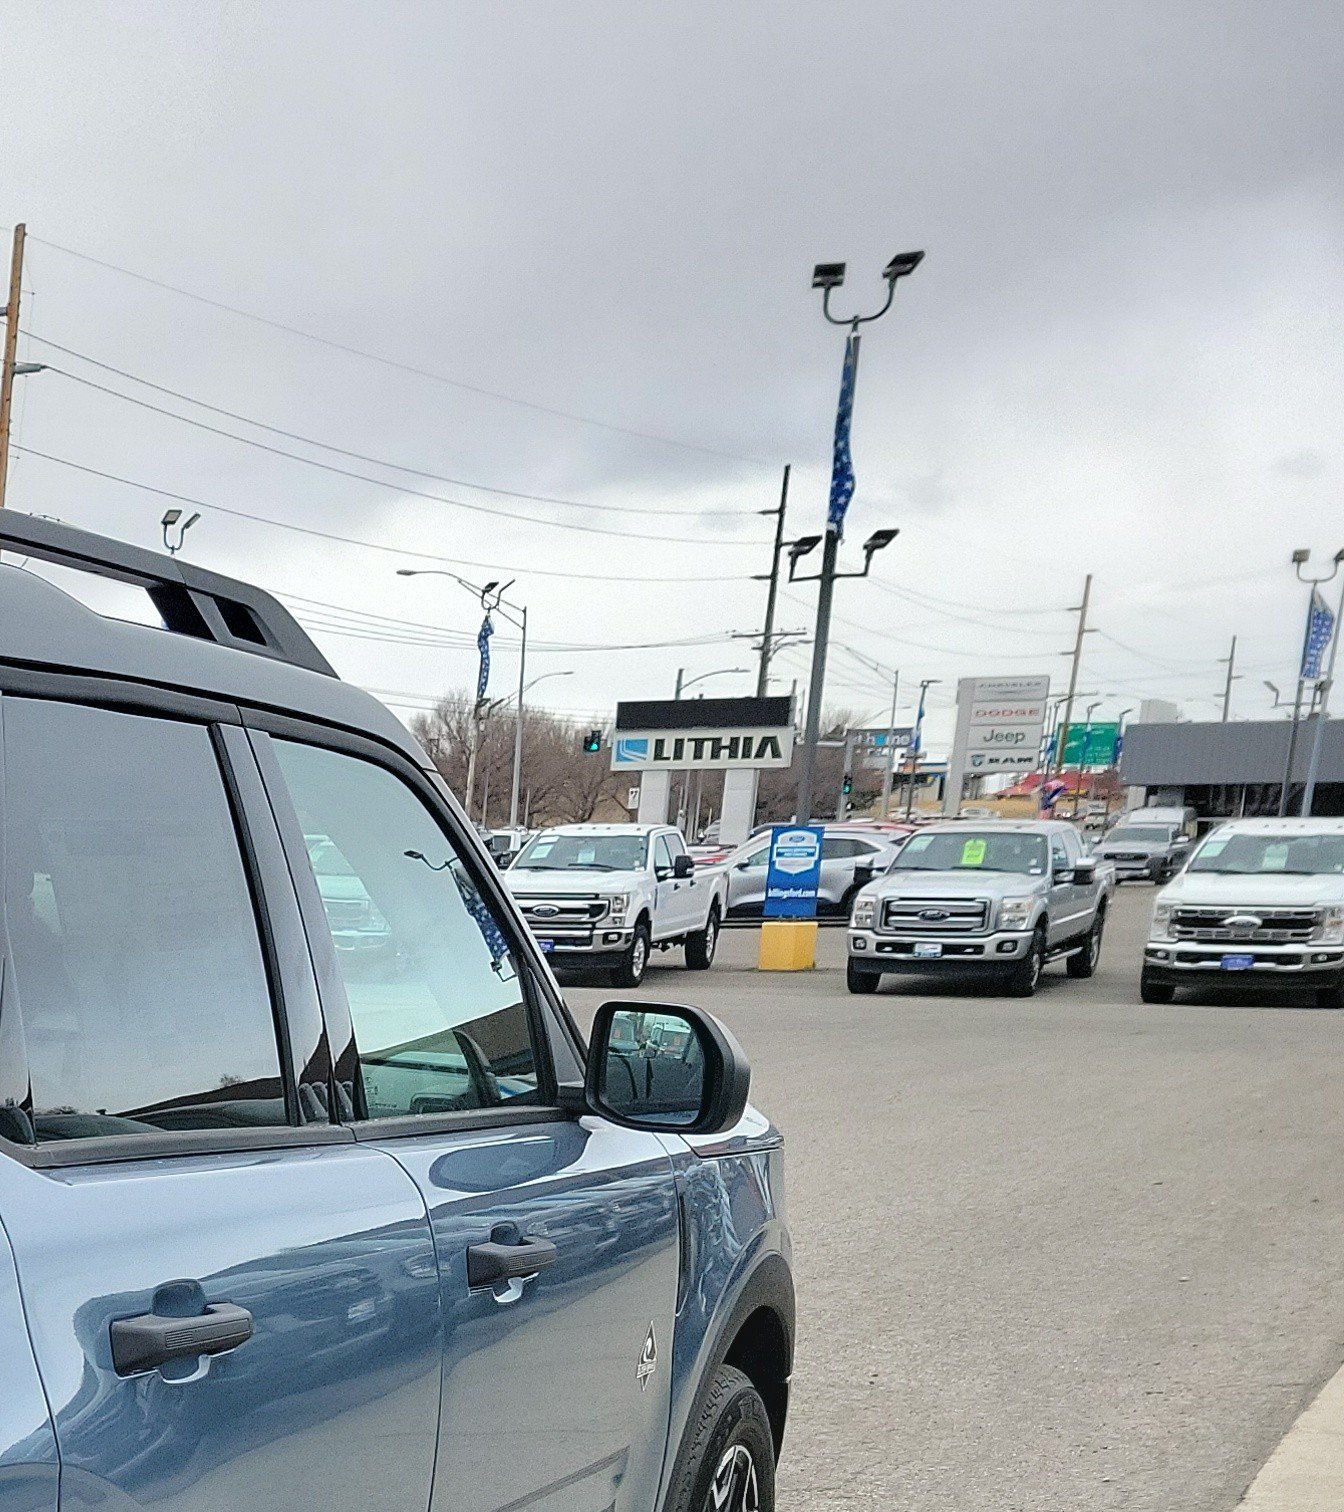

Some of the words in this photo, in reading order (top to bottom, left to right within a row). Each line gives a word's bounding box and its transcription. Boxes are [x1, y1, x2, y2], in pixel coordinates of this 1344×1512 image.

[975, 708, 1039, 717] DODGE
[983, 729, 1026, 744] Jeep
[653, 735, 783, 761] LITHIA
